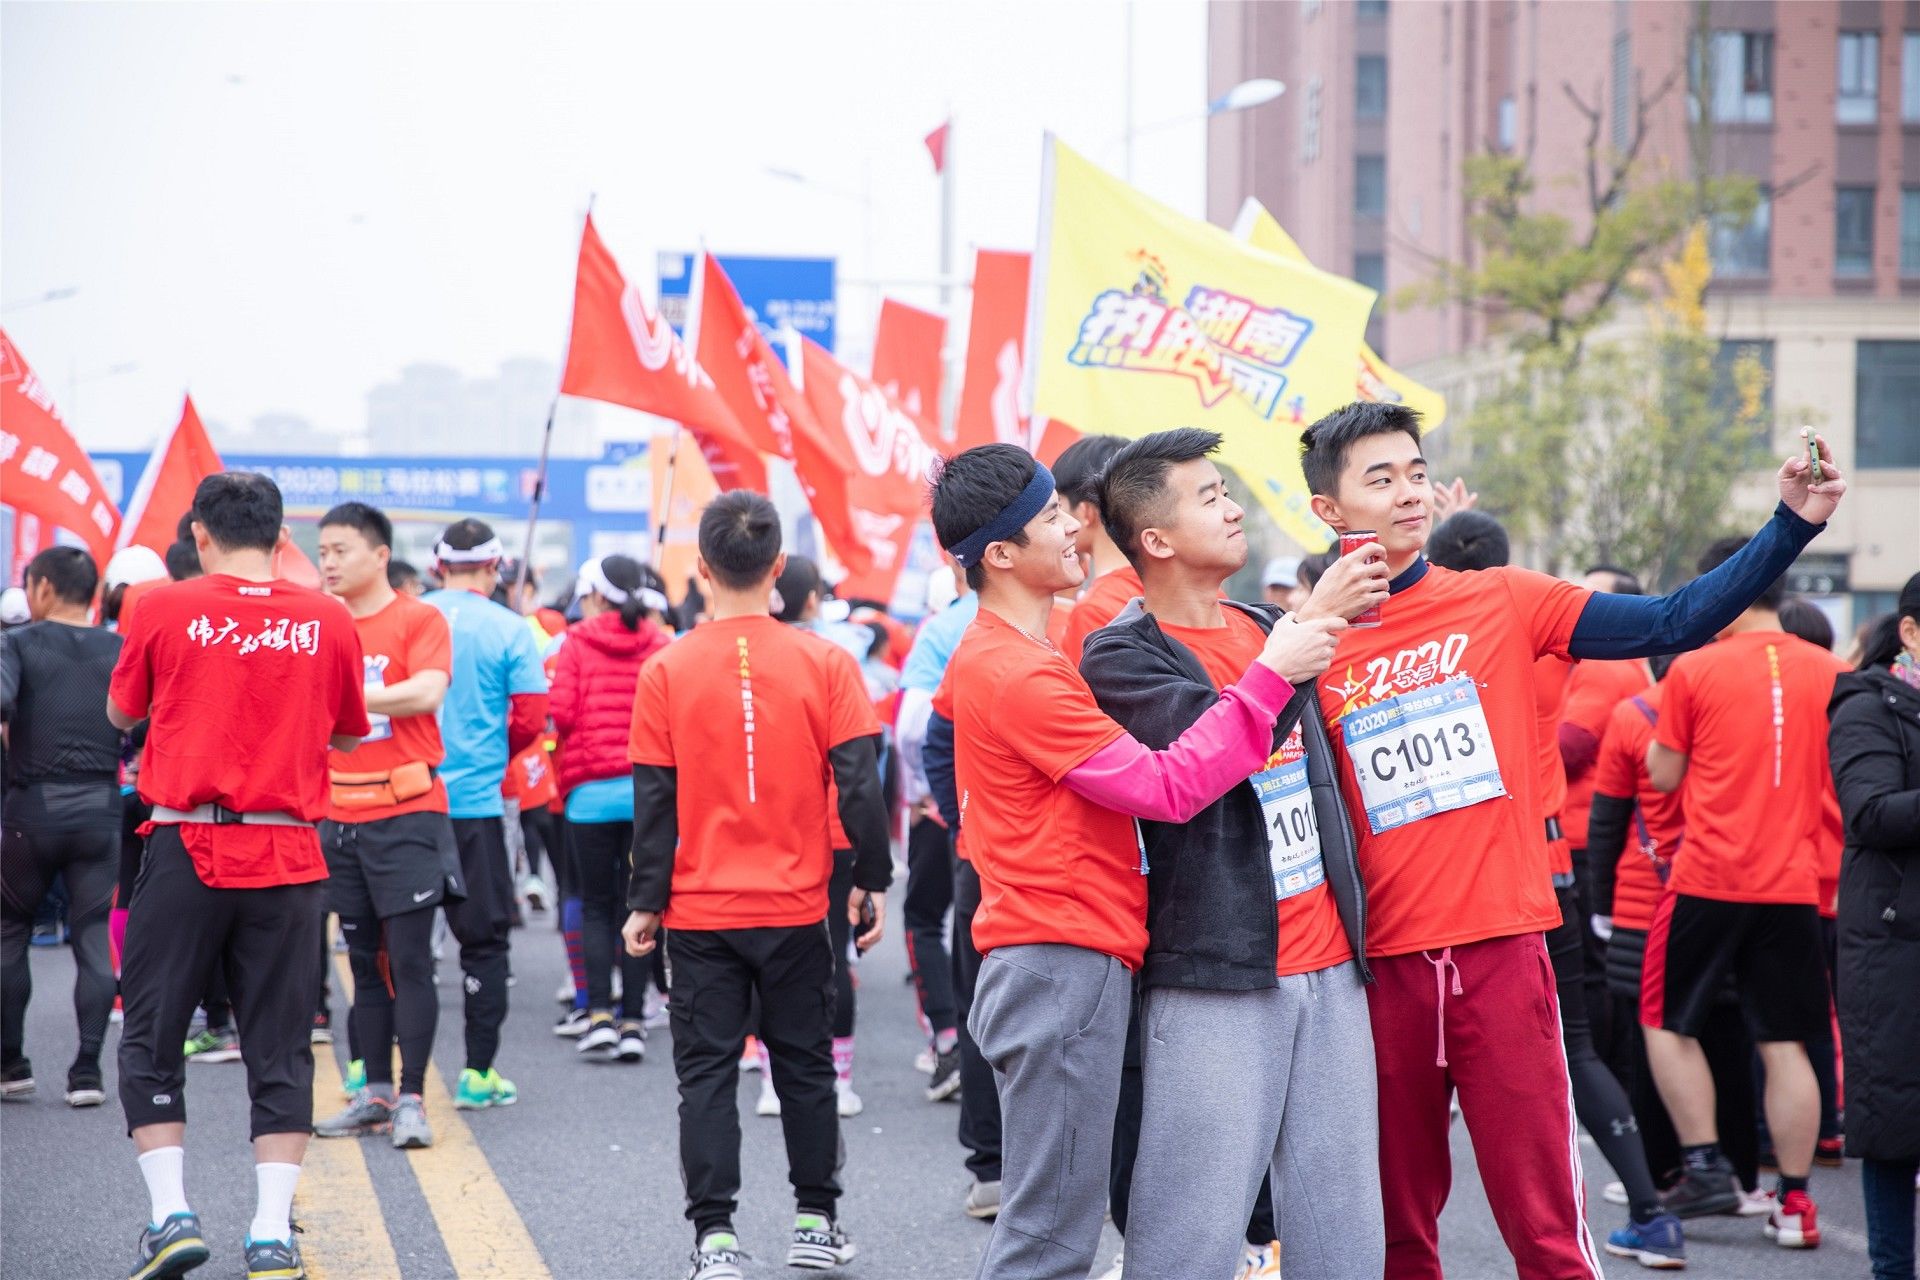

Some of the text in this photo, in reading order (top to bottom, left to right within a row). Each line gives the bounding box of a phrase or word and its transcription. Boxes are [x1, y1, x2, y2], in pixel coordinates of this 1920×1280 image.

[187, 614, 320, 656] 伟大的祖国
[1366, 633, 1469, 700] 2020
[1357, 710, 1389, 735] 2020
[1371, 722, 1476, 782] C1013
[1268, 801, 1319, 850] 101
